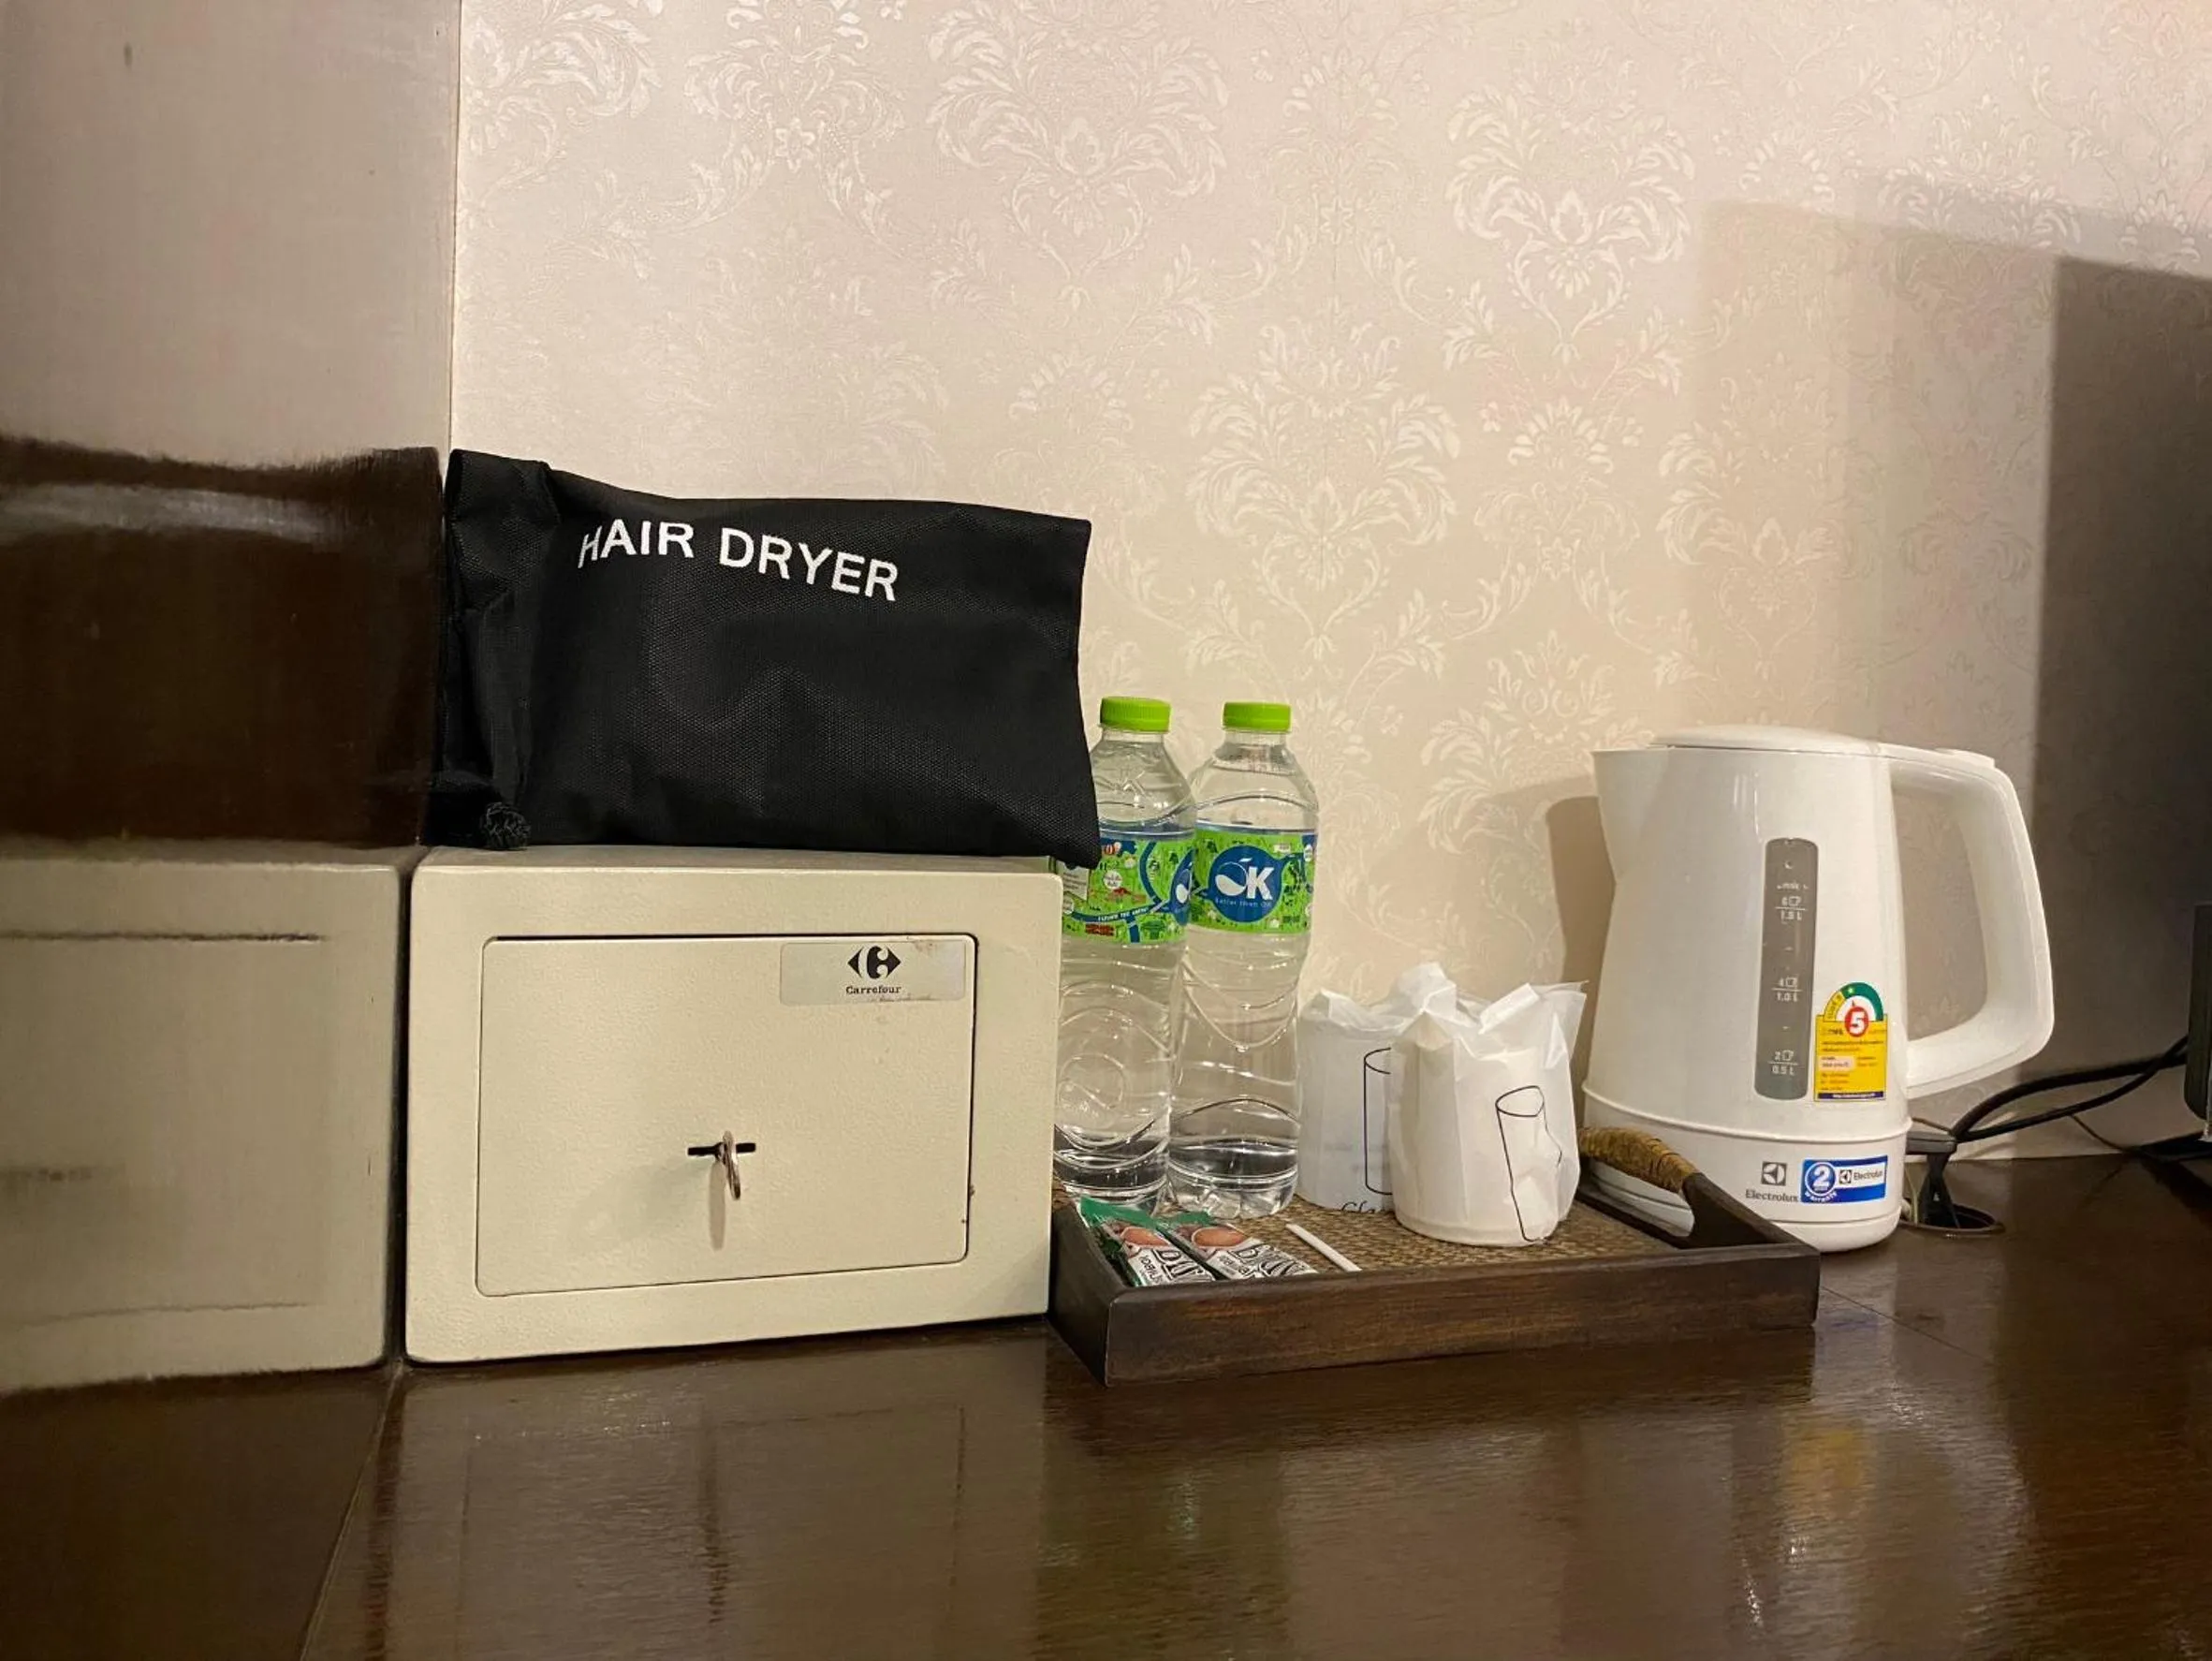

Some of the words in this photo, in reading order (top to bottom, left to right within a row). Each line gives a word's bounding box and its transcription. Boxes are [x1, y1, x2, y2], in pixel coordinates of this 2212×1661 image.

[578, 518, 695, 569] HAIR
[719, 527, 899, 601] DRYER
[1215, 859, 1274, 900] OK
[845, 985, 901, 995] Carrefour
[1849, 1010, 1866, 1035] 5
[1813, 1165, 1830, 1187] 2
[1853, 1169, 1882, 1181] Electrolux
[1745, 1188, 1798, 1202] Electrolux
